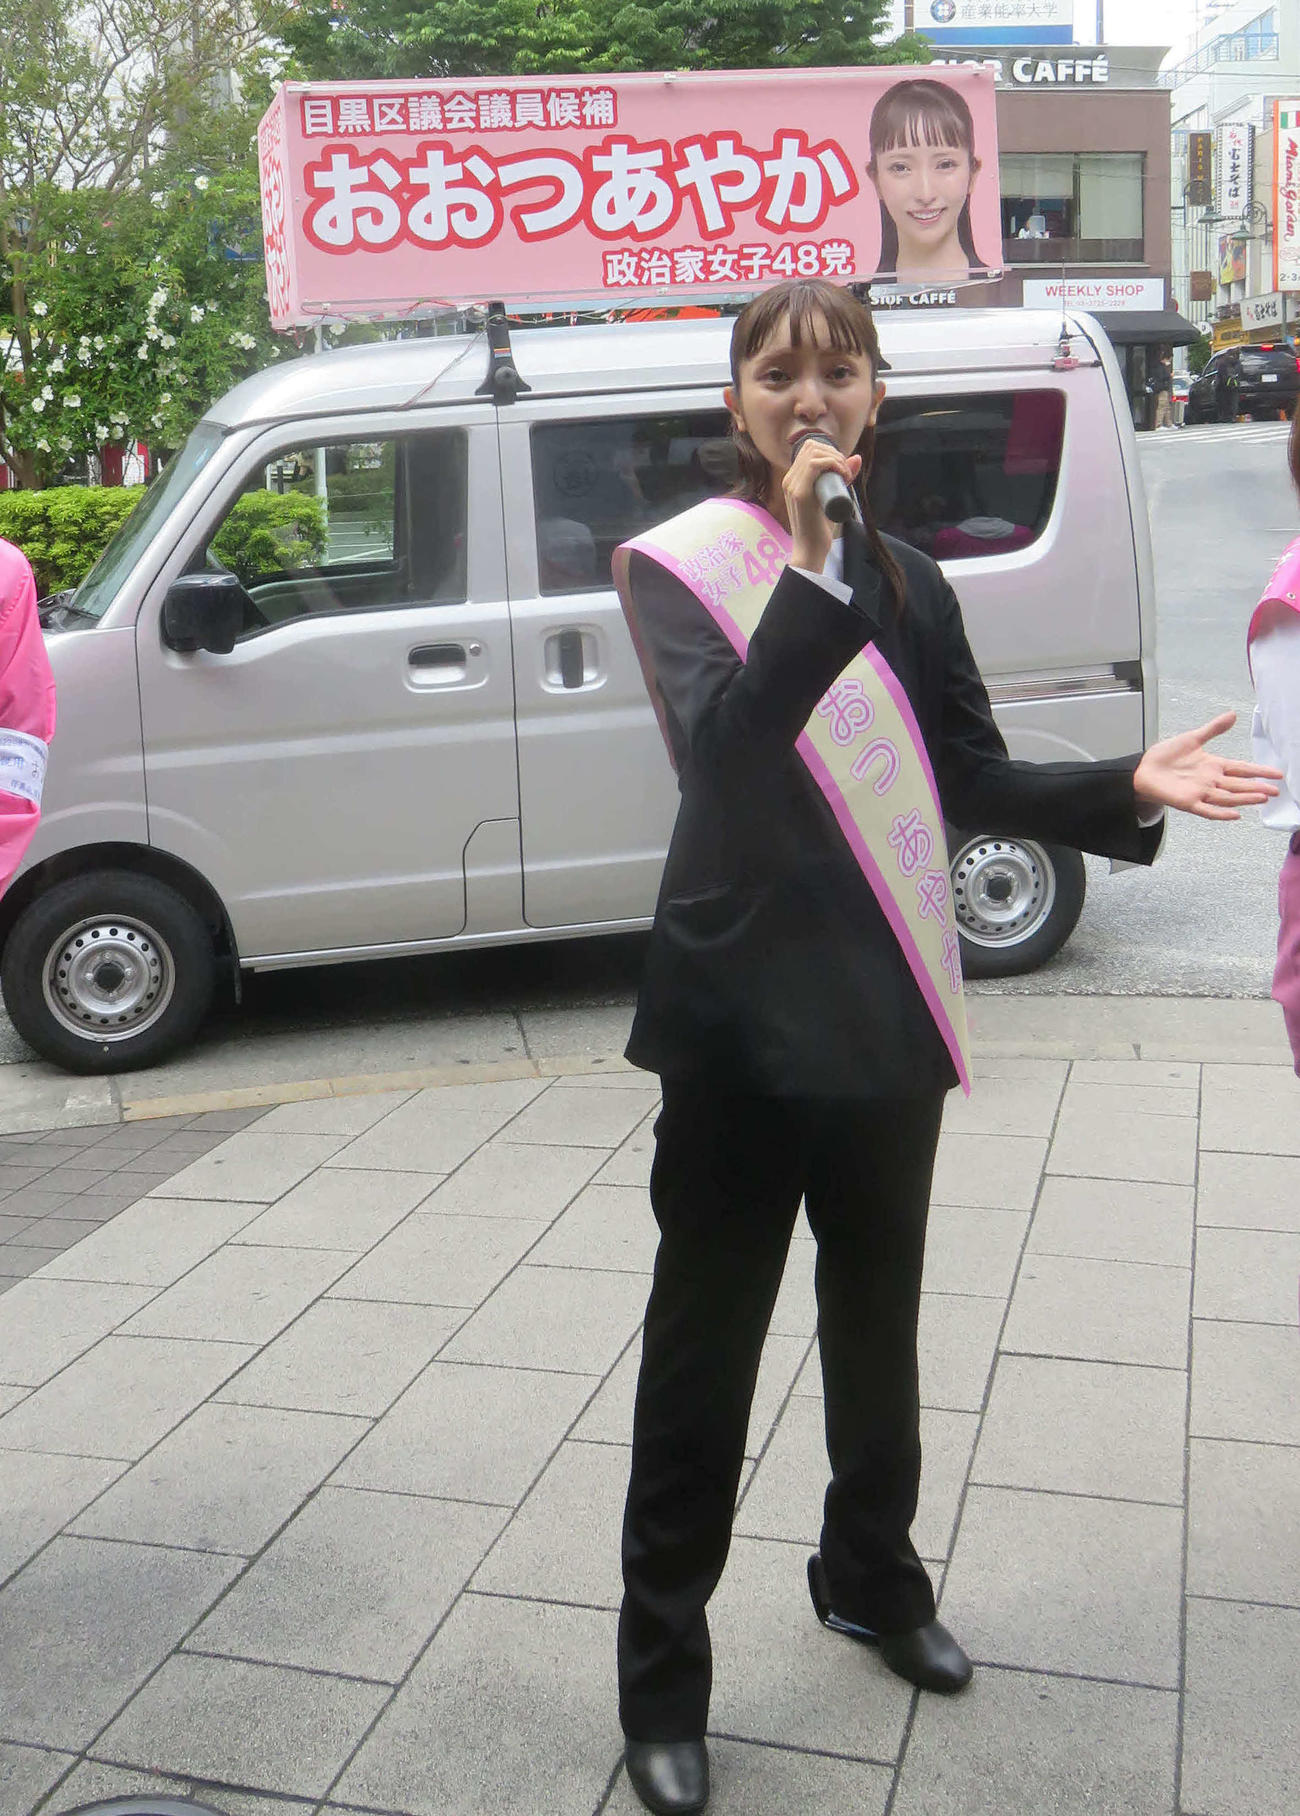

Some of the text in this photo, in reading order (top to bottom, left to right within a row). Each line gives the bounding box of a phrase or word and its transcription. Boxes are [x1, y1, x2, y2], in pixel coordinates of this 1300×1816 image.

[1012, 54, 1110, 83] CAFFÉ
[302, 88, 617, 136] 目黒区議会議員候補
[306, 131, 857, 252] おおつあやか
[604, 242, 853, 287] 政治家女子48党
[909, 289, 956, 305] CAFFÉ
[1045, 284, 1144, 297] WEEKLY SHOP
[677, 528, 745, 583] 政治家
[701, 564, 744, 607] 女子
